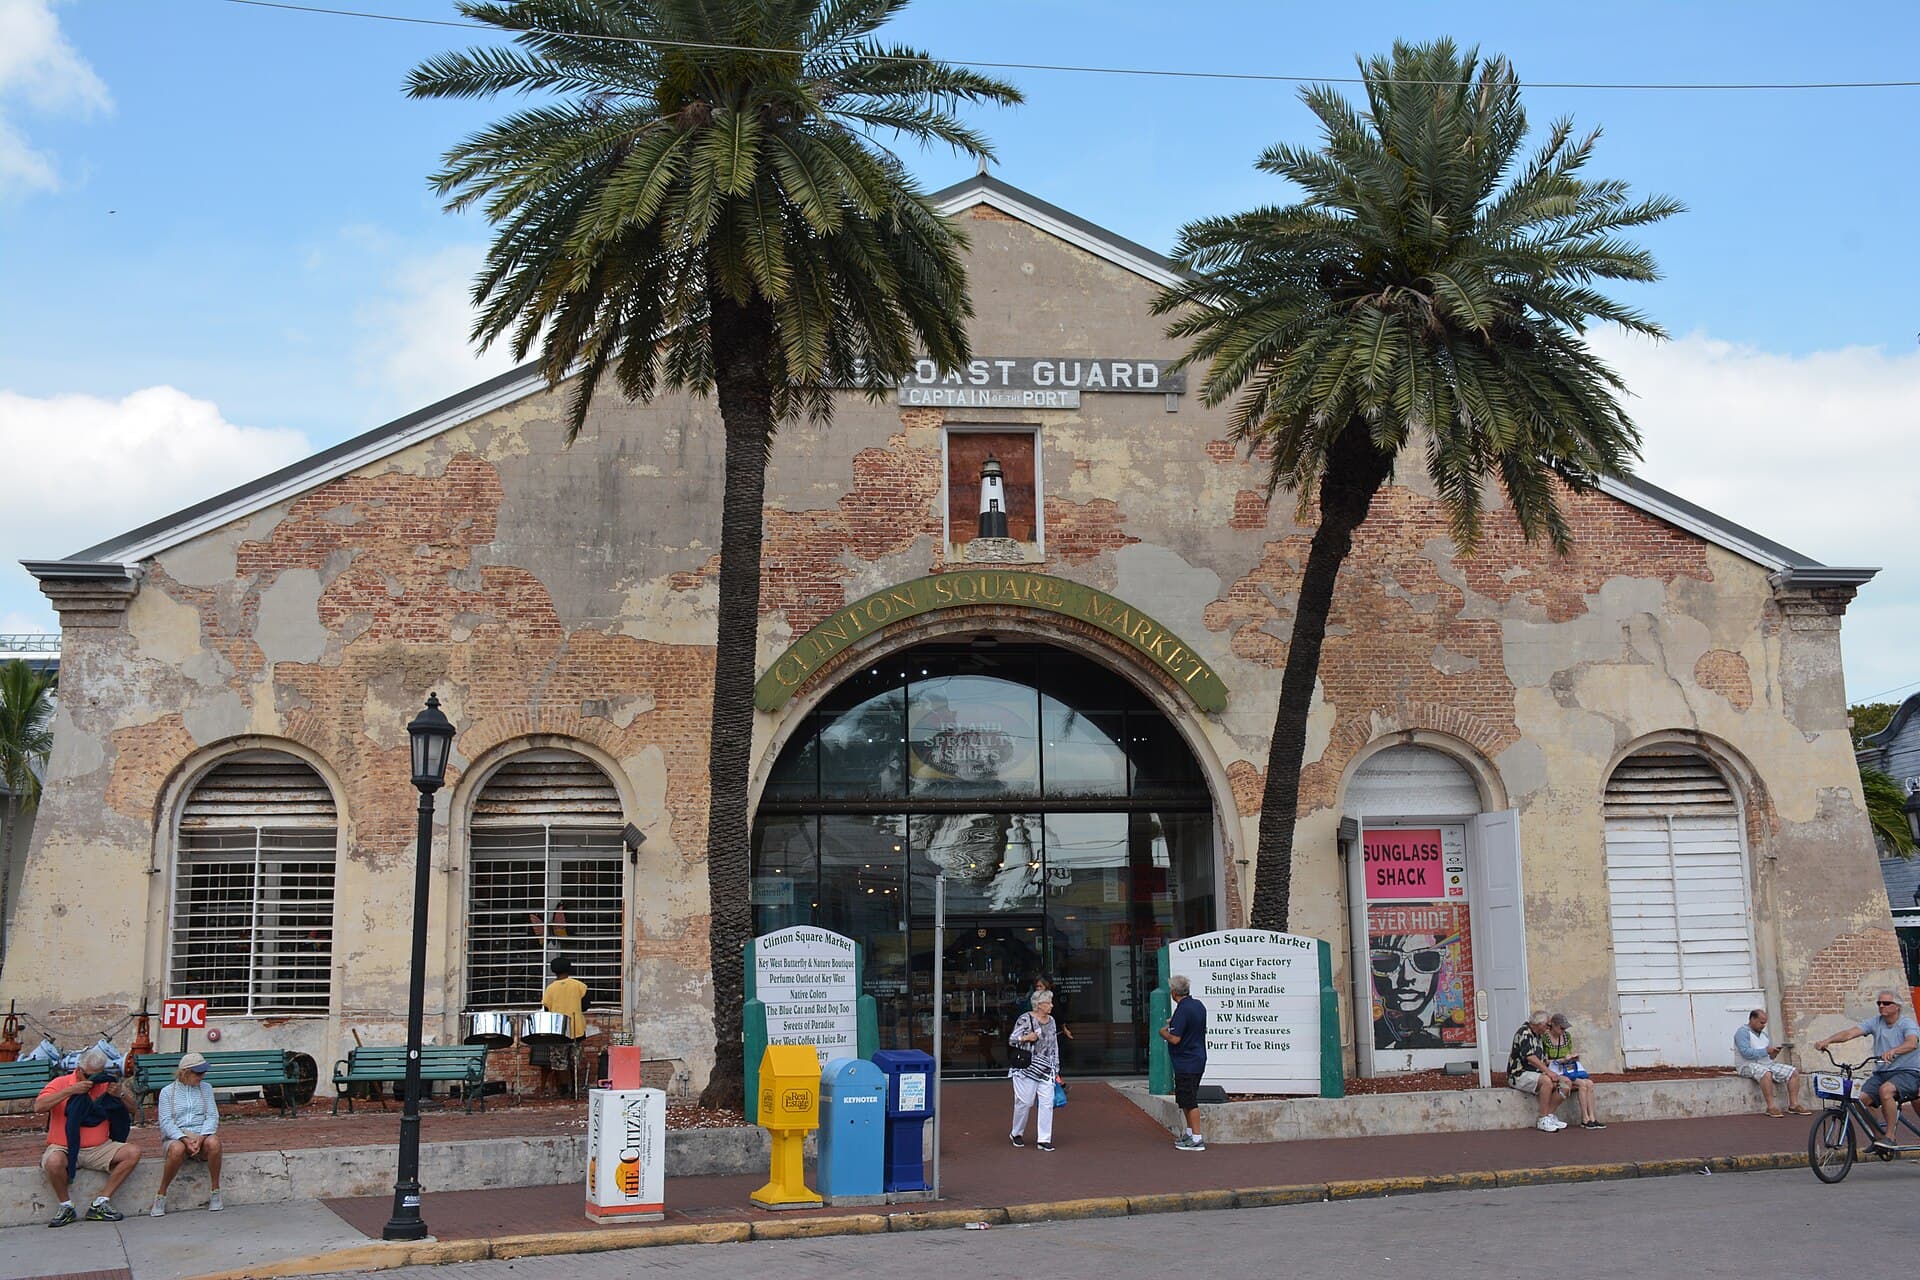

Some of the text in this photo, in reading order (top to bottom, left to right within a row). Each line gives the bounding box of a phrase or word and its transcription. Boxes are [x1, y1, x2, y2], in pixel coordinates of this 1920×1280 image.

[901, 360, 1016, 386] OAST
[1033, 361, 1159, 388] GUARD
[909, 389, 990, 406] CAPTAIN
[1023, 391, 1069, 407] PORT
[775, 573, 1210, 687] CLINTON SQUARE MARKET
[1364, 844, 1439, 862] SUNGLASS
[1377, 868, 1426, 886] SHACK
[1368, 911, 1450, 931] EVER HIDE
[763, 931, 851, 952] Clinton Square Market
[1178, 934, 1311, 953] Clinton Square Market
[758, 958, 769, 970] Key
[770, 958, 783, 968] West
[784, 958, 807, 970] Butterfly
[814, 958, 831, 968] Nature
[832, 958, 855, 970] Boutique
[1199, 957, 1291, 969] Island Cigar Factory
[769, 973, 846, 985] Perfume Outlet of Key West
[1211, 971, 1277, 983] Sunglass Shack
[790, 989, 827, 999] Native Colors
[1204, 985, 1285, 996] Fishing in Paradise
[767, 1003, 850, 1016] The Blue Cat and Red Dog Too
[1220, 999, 1270, 1009] 3-D Mini Me
[164, 1003, 205, 1025] FDC
[1217, 1013, 1278, 1022] KW Kidswear
[783, 1020, 835, 1031] Sweets of Paradise
[1205, 1026, 1291, 1035] ature's Treasures
[797, 1035, 816, 1046] Coffee
[822, 1034, 836, 1044] Juice
[837, 1034, 847, 1043] Bar
[1207, 1041, 1291, 1052] Purr Fit Toe Rings
[791, 1091, 809, 1101] Real
[843, 1096, 878, 1104] KEYNOTER
[619, 1099, 641, 1201] THE CITIZEN
